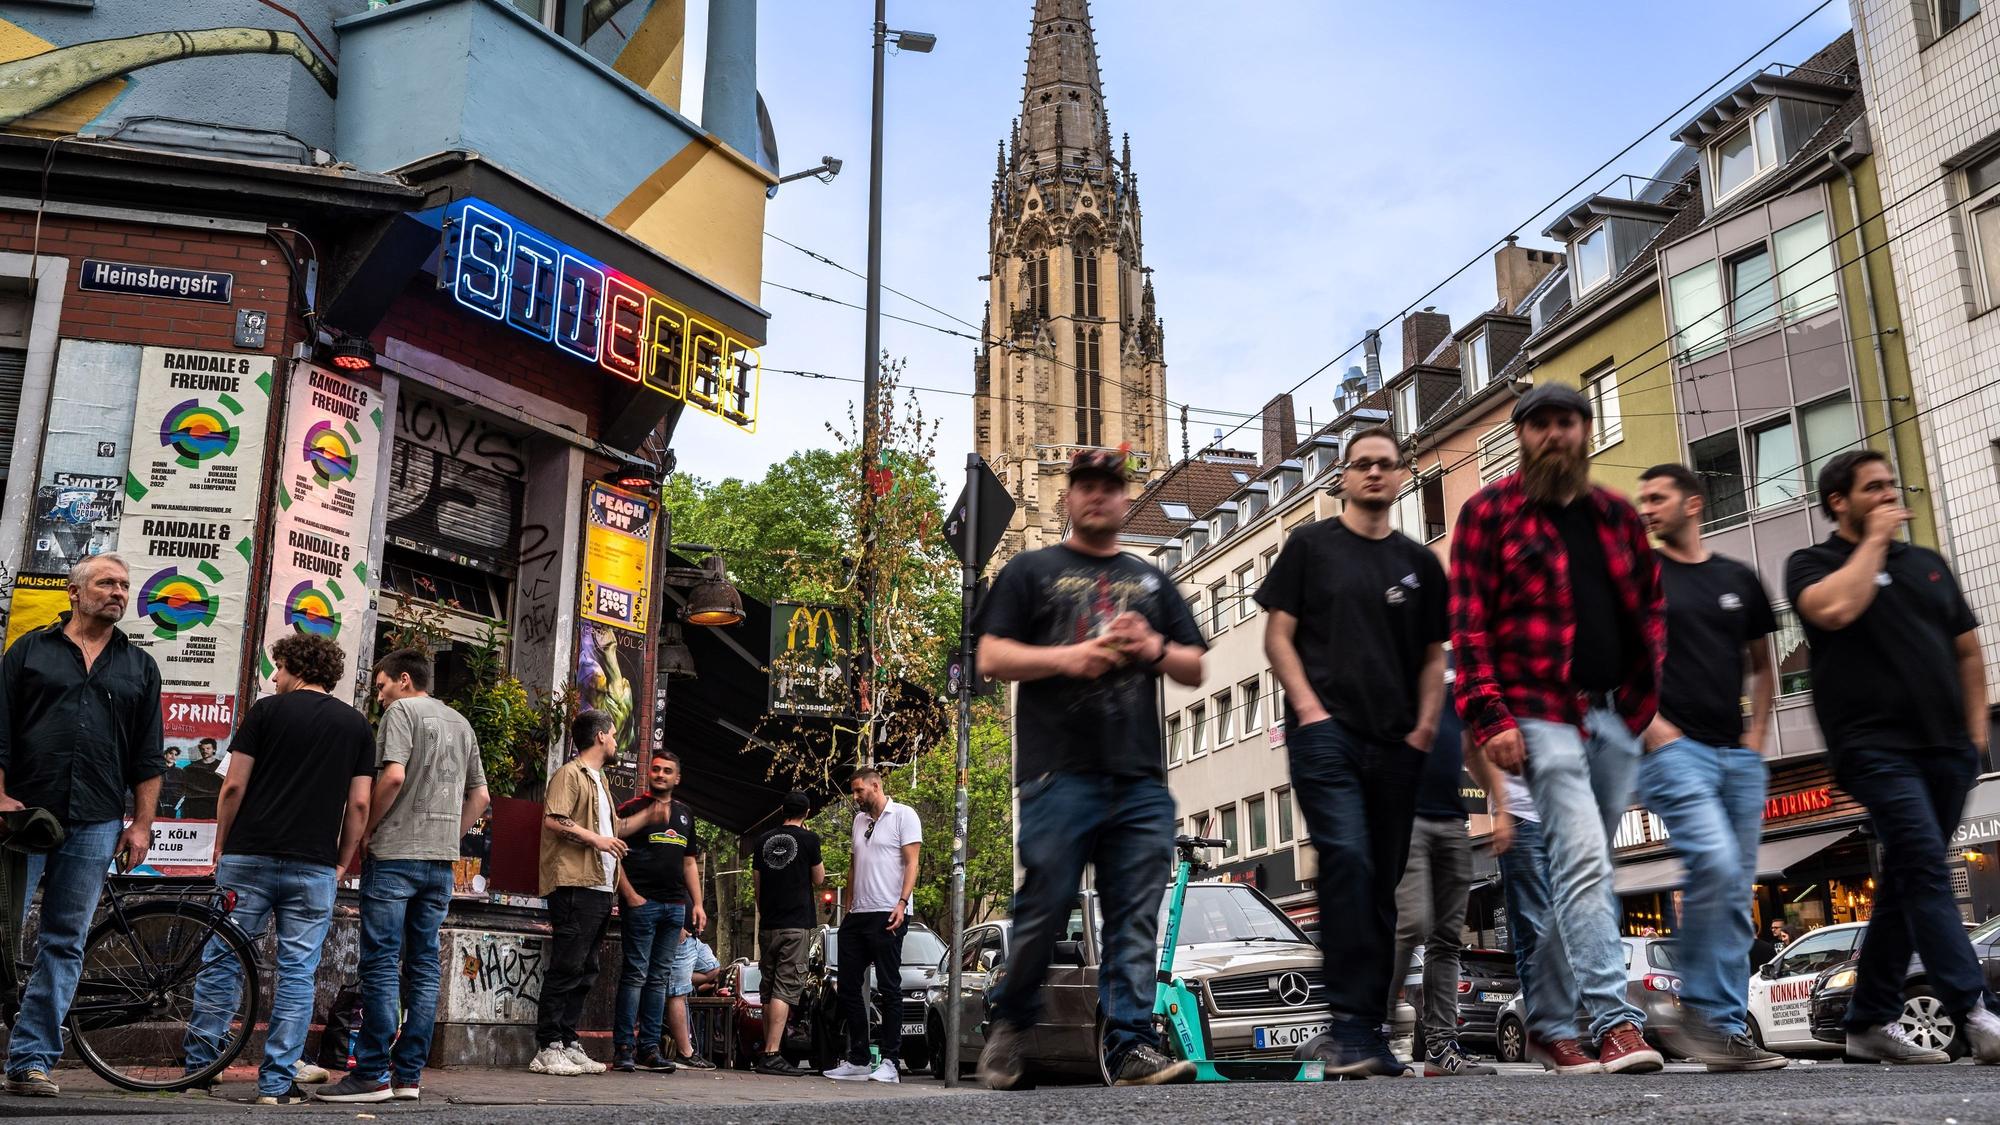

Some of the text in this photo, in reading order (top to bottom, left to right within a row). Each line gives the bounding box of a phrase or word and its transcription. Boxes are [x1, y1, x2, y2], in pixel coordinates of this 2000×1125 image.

[95, 264, 218, 295] Heinsbergstr.
[164, 353, 250, 374] RANDALE &
[170, 372, 240, 392] FREUNDE
[309, 370, 368, 407] RANDALE &
[312, 391, 360, 422] FREUNDE
[596, 492, 645, 520] PEACH
[142, 520, 231, 540] RANDALE &
[606, 512, 631, 530] PIT
[148, 540, 220, 560] FREUNDE
[288, 530, 350, 562] RANDALE &
[292, 552, 343, 579] FREUNDE
[600, 588, 629, 604] FROM
[168, 703, 231, 724] SPRING
[1781, 788, 1830, 816] DRINKS
[168, 829, 197, 839] KÖLN
[1160, 922, 1175, 966] TIER
[1770, 982, 1798, 1003] NONNA
[912, 1025, 922, 1034] KG
[1178, 1020, 1194, 1055] TIER
[1270, 1030, 1280, 1046] K
